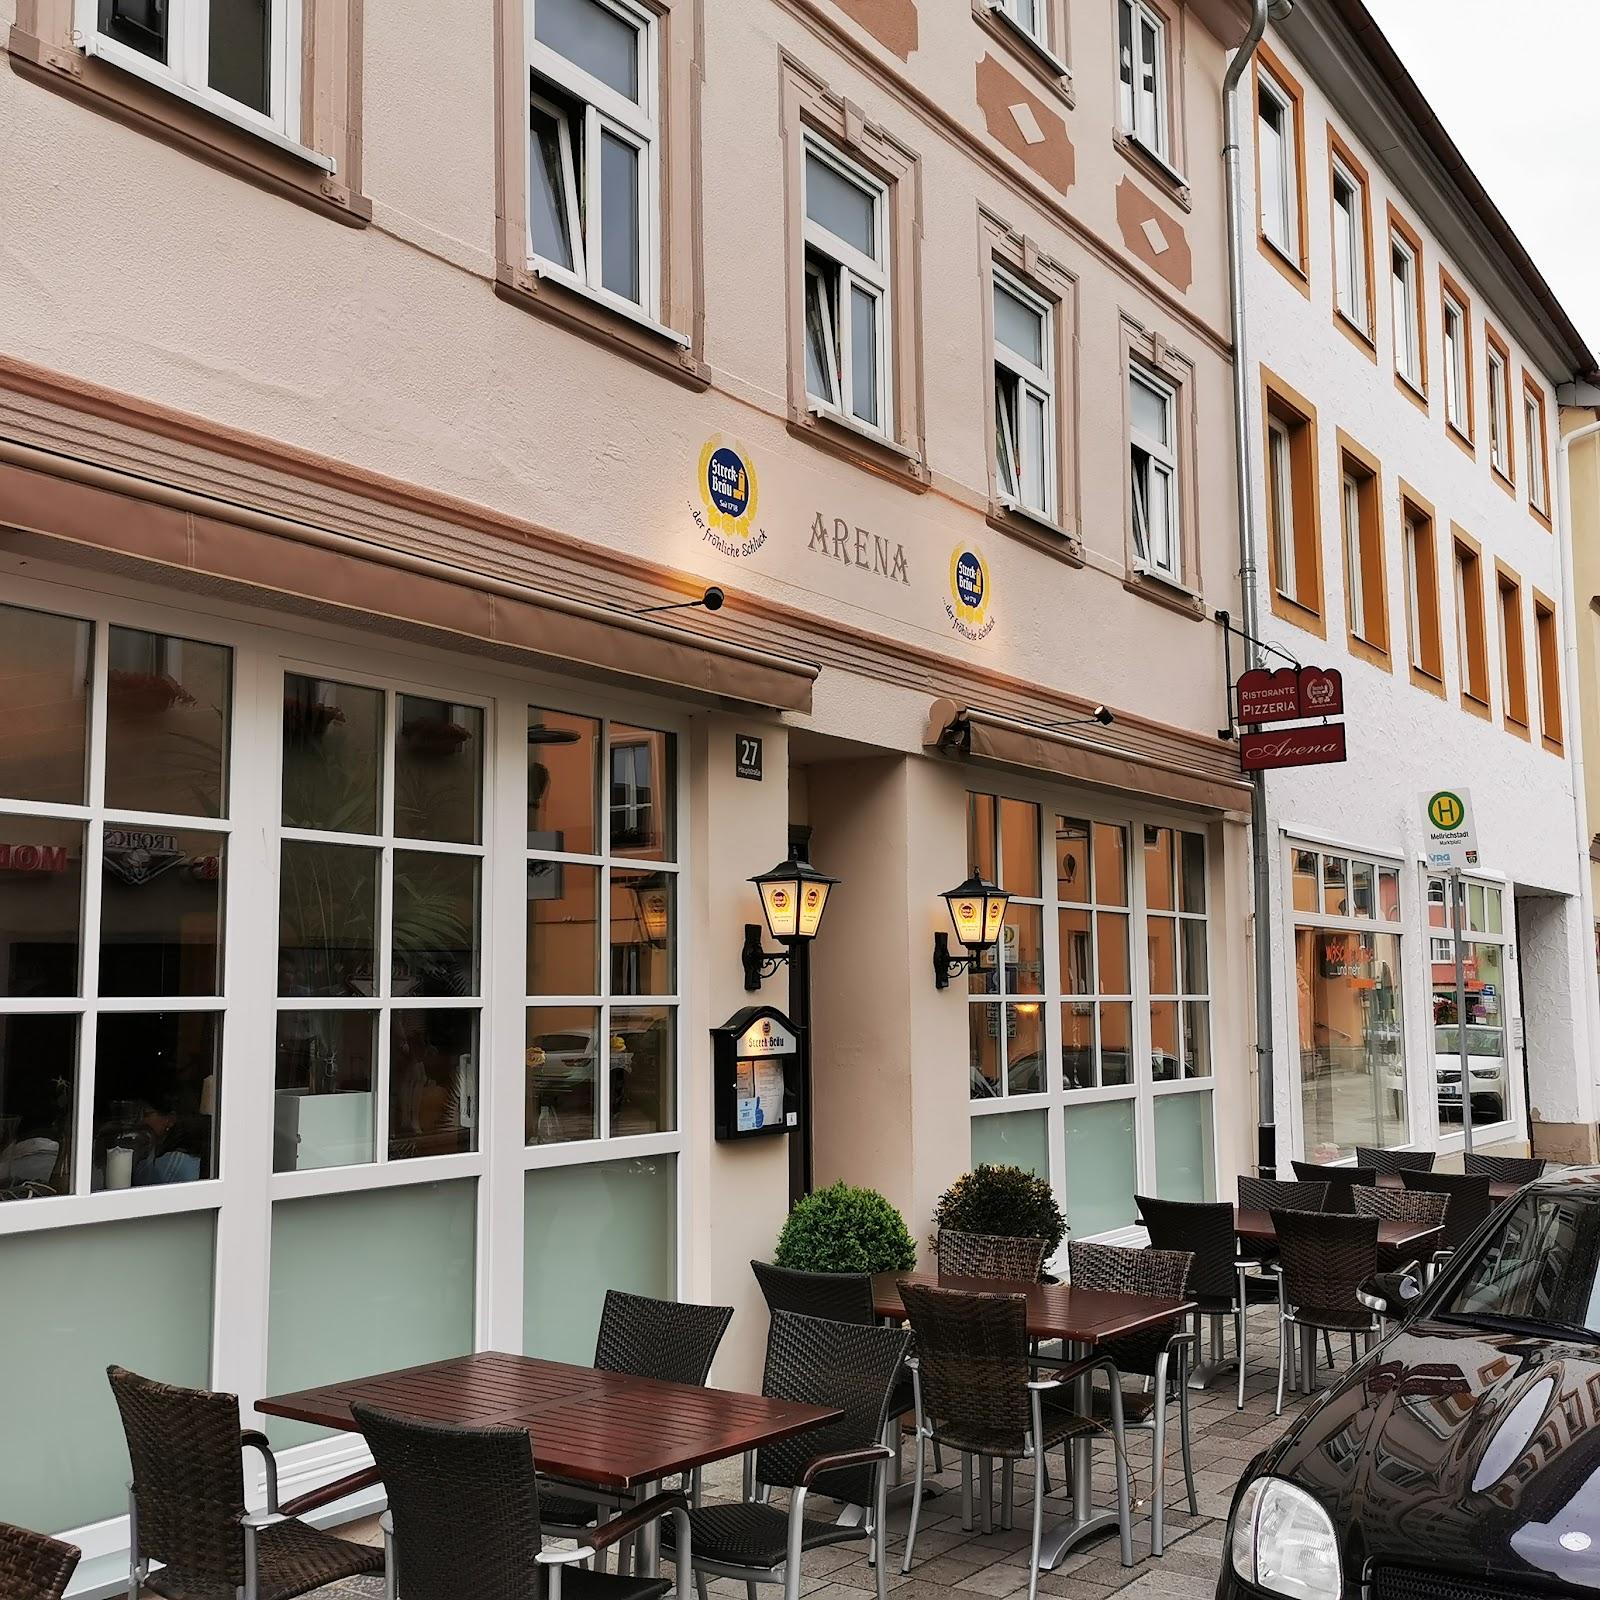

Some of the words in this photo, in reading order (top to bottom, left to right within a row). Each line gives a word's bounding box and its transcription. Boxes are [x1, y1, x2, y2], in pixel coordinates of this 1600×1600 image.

[702, 528, 740, 558] fröhliche
[741, 528, 768, 557] Schluck
[807, 511, 910, 585] ARENA
[1241, 686, 1296, 700] RISTORANTE
[1242, 700, 1296, 717] PIZZERIA
[741, 739, 758, 766] 27
[1245, 737, 1337, 760] Arena
[1437, 799, 1455, 822] H
[1430, 831, 1470, 840] Mellrichstadt
